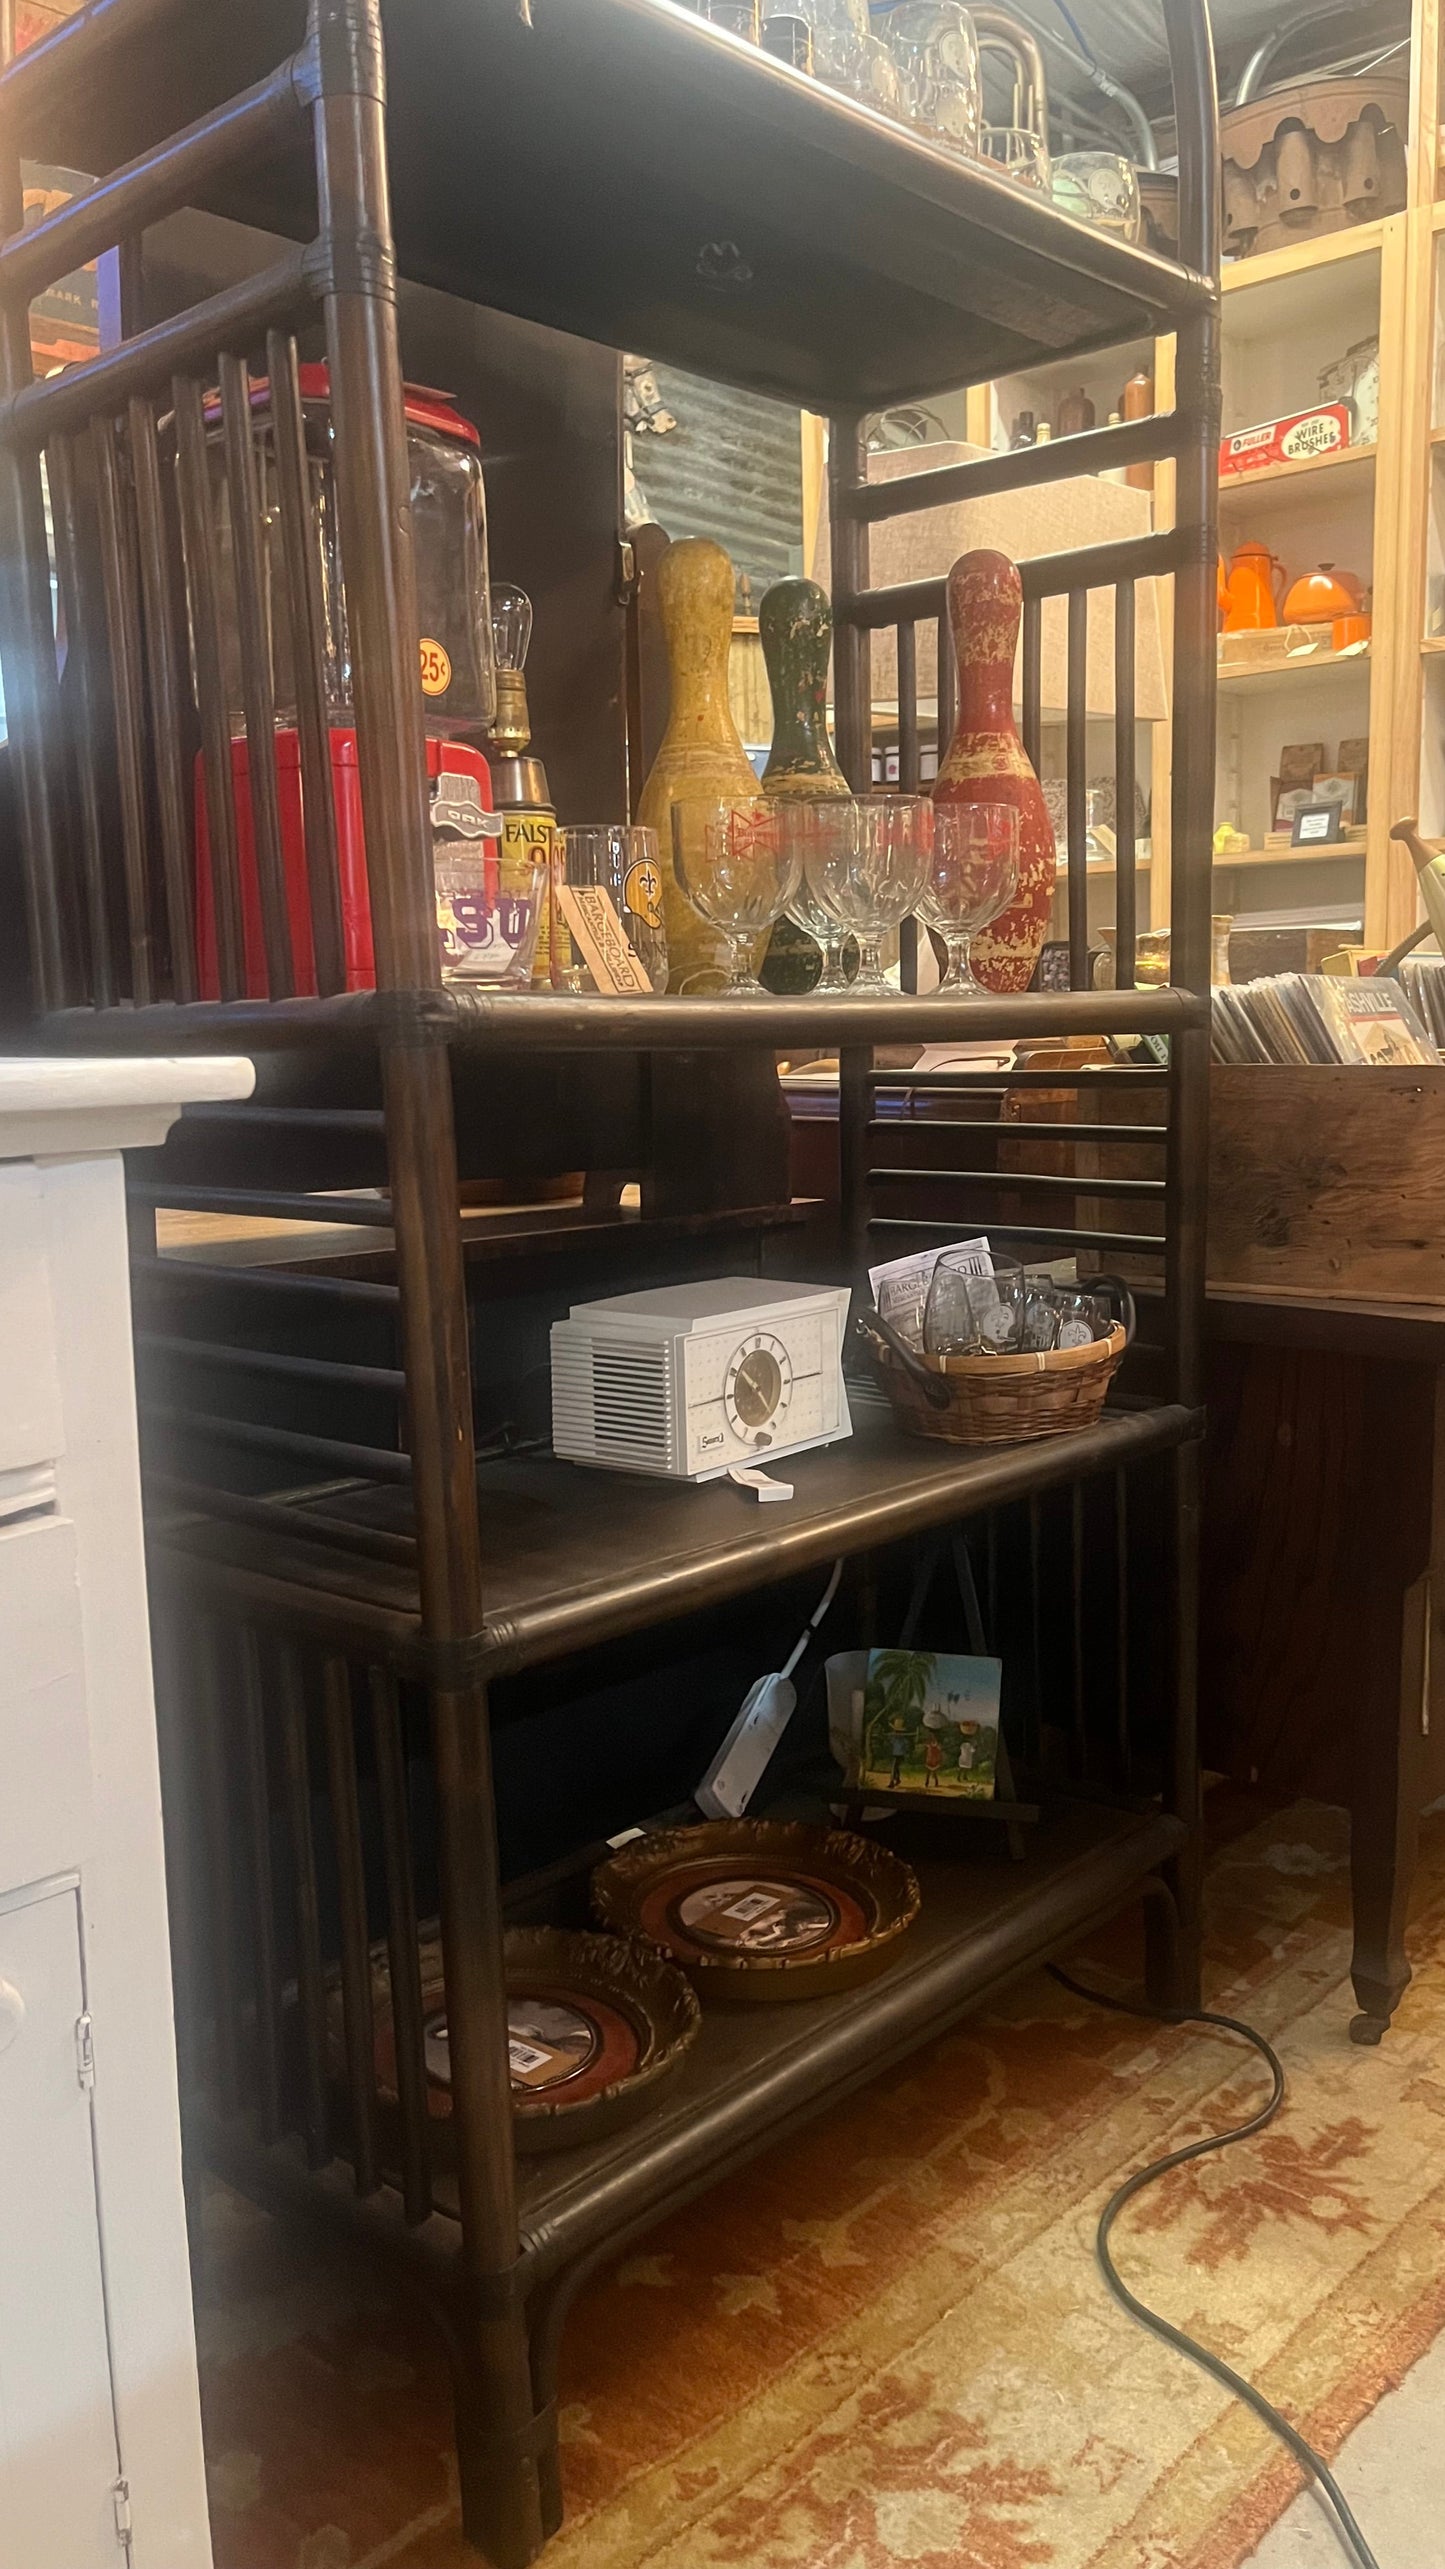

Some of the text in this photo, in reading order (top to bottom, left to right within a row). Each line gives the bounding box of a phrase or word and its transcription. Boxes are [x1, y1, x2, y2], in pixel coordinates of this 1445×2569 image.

[1243, 431, 1271, 447] FULLER
[1297, 423, 1324, 439] WIRE
[584, 894, 635, 988] BARGEBOARD
